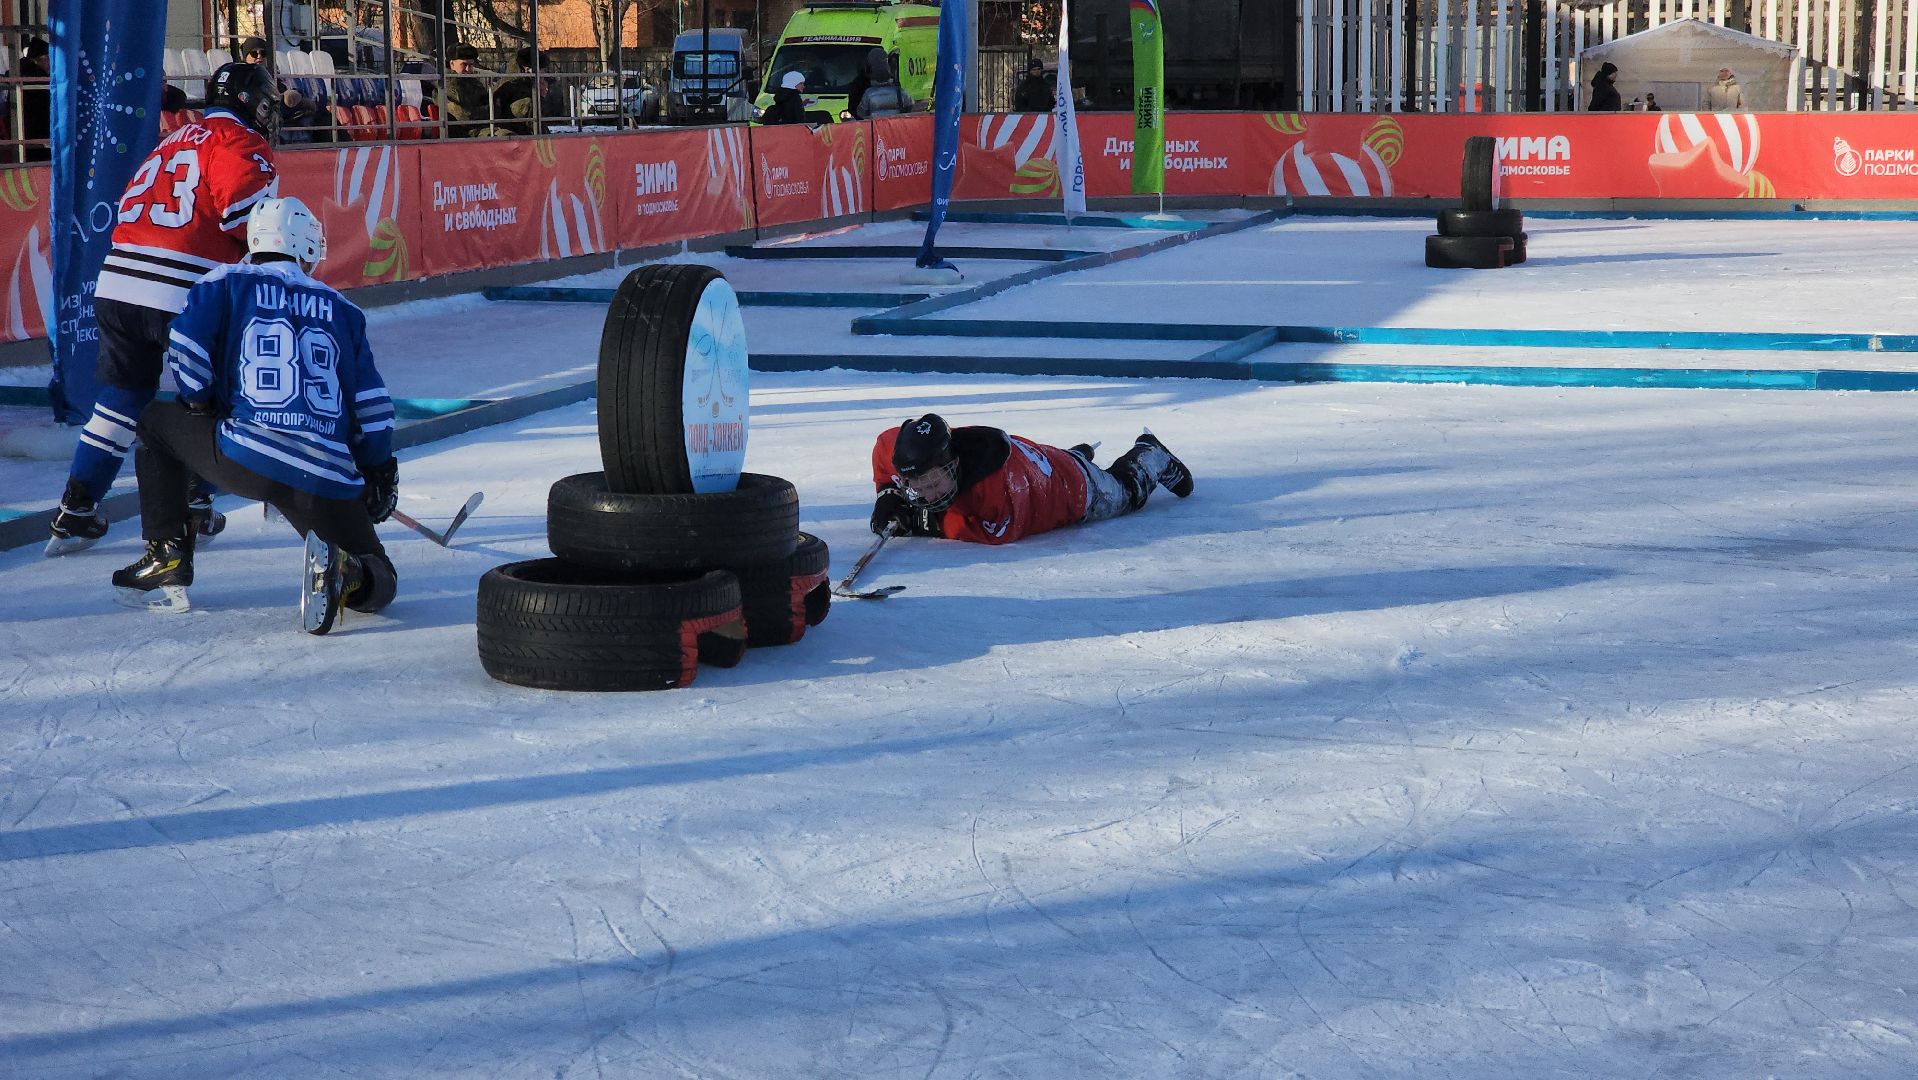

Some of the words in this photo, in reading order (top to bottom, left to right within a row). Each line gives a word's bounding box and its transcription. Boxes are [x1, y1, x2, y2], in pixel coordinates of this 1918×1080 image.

[888, 147, 906, 162] ПАРКИ
[1165, 141, 1200, 153] ных
[1496, 136, 1570, 160] ИМА
[1865, 149, 1914, 161] ПАРКИ
[888, 160, 929, 179] ПОДМОСКОВЬЯ
[1120, 158, 1131, 170] и
[1163, 154, 1228, 172] бодных
[1501, 165, 1570, 176] ДМОСКОВЬЕ
[118, 148, 200, 228] 23
[635, 159, 678, 196] ЗИМА
[433, 180, 457, 211] Для
[459, 182, 498, 209] умных
[445, 212, 454, 232] и
[455, 204, 518, 231] свободных
[240, 316, 342, 419] 89
[688, 414, 744, 458] ПОНД-ХОККЕЙ
